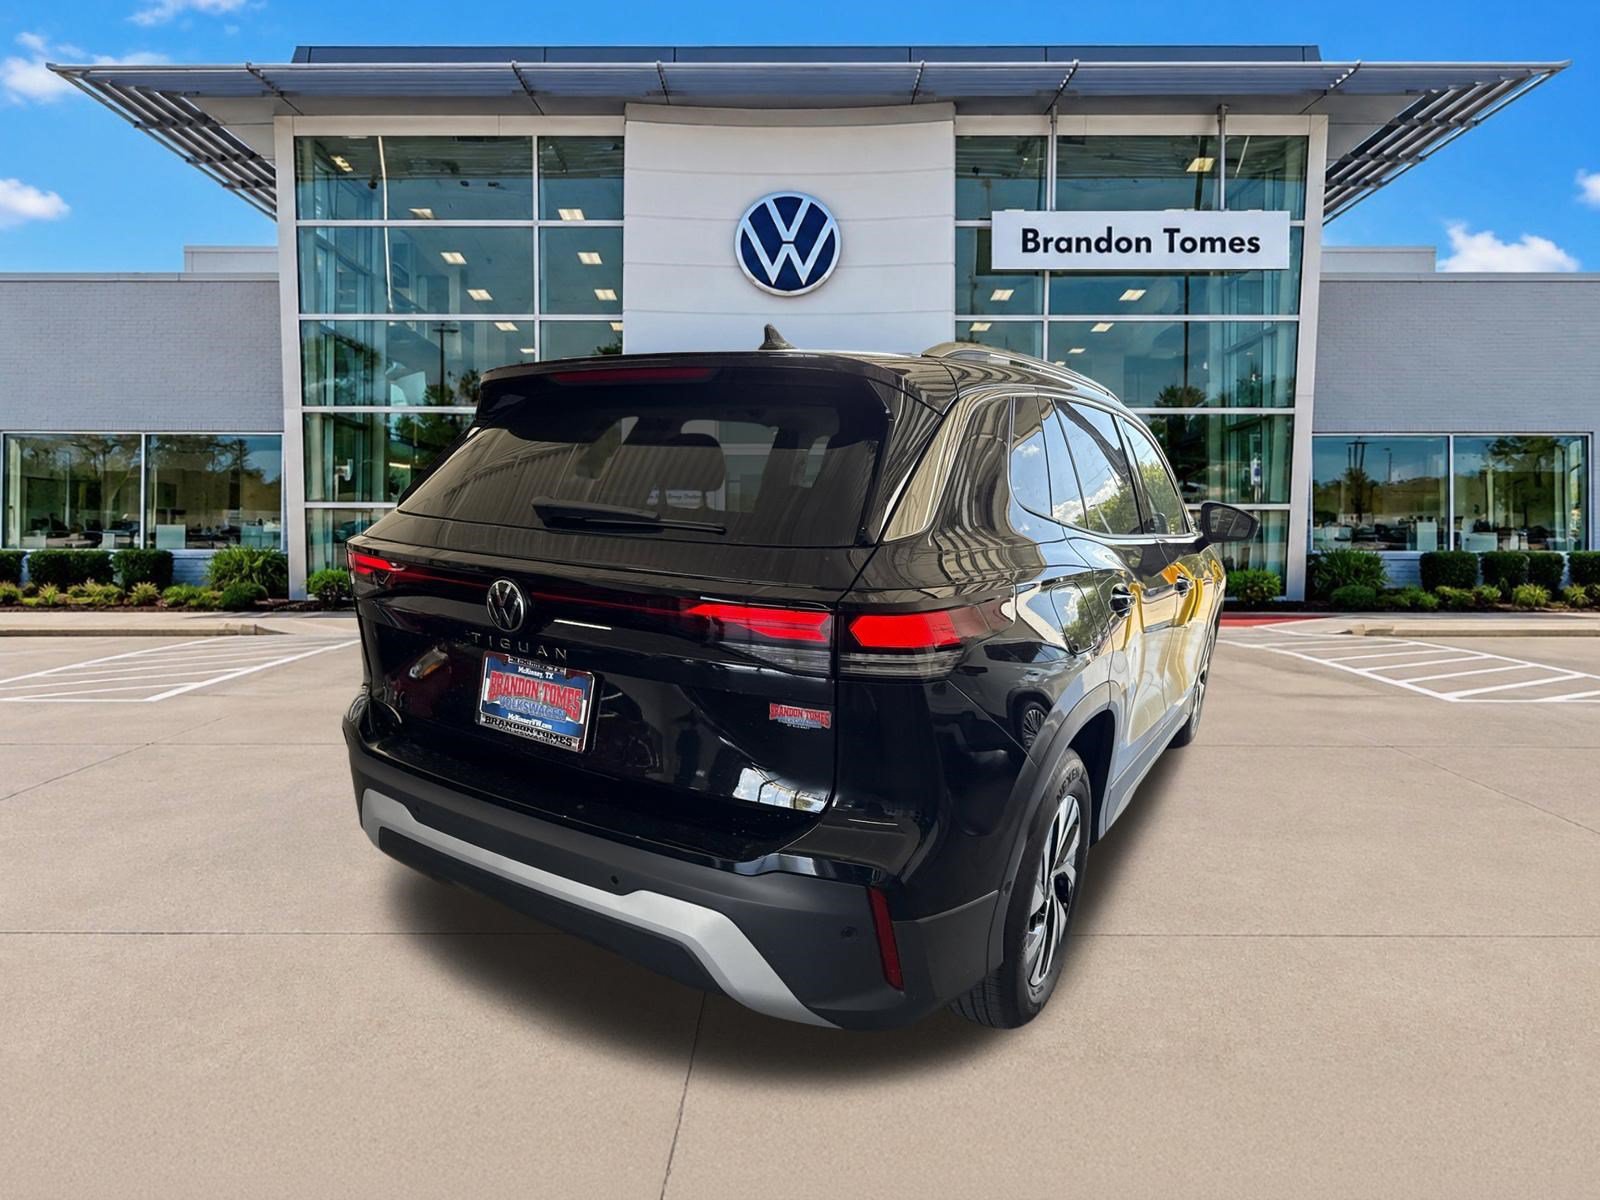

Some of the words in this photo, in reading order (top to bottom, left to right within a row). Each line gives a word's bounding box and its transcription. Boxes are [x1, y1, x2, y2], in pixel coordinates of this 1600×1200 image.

[1021, 226, 1152, 254] Brandon
[1162, 227, 1261, 254] Tomes
[471, 631, 567, 659] TIGUAN
[488, 670, 541, 701] BRANDON
[543, 682, 582, 720] TOMES
[499, 695, 566, 719] VOLKSWAGEN
[485, 716, 534, 735] BRANDON
[535, 728, 573, 746] TOMES
